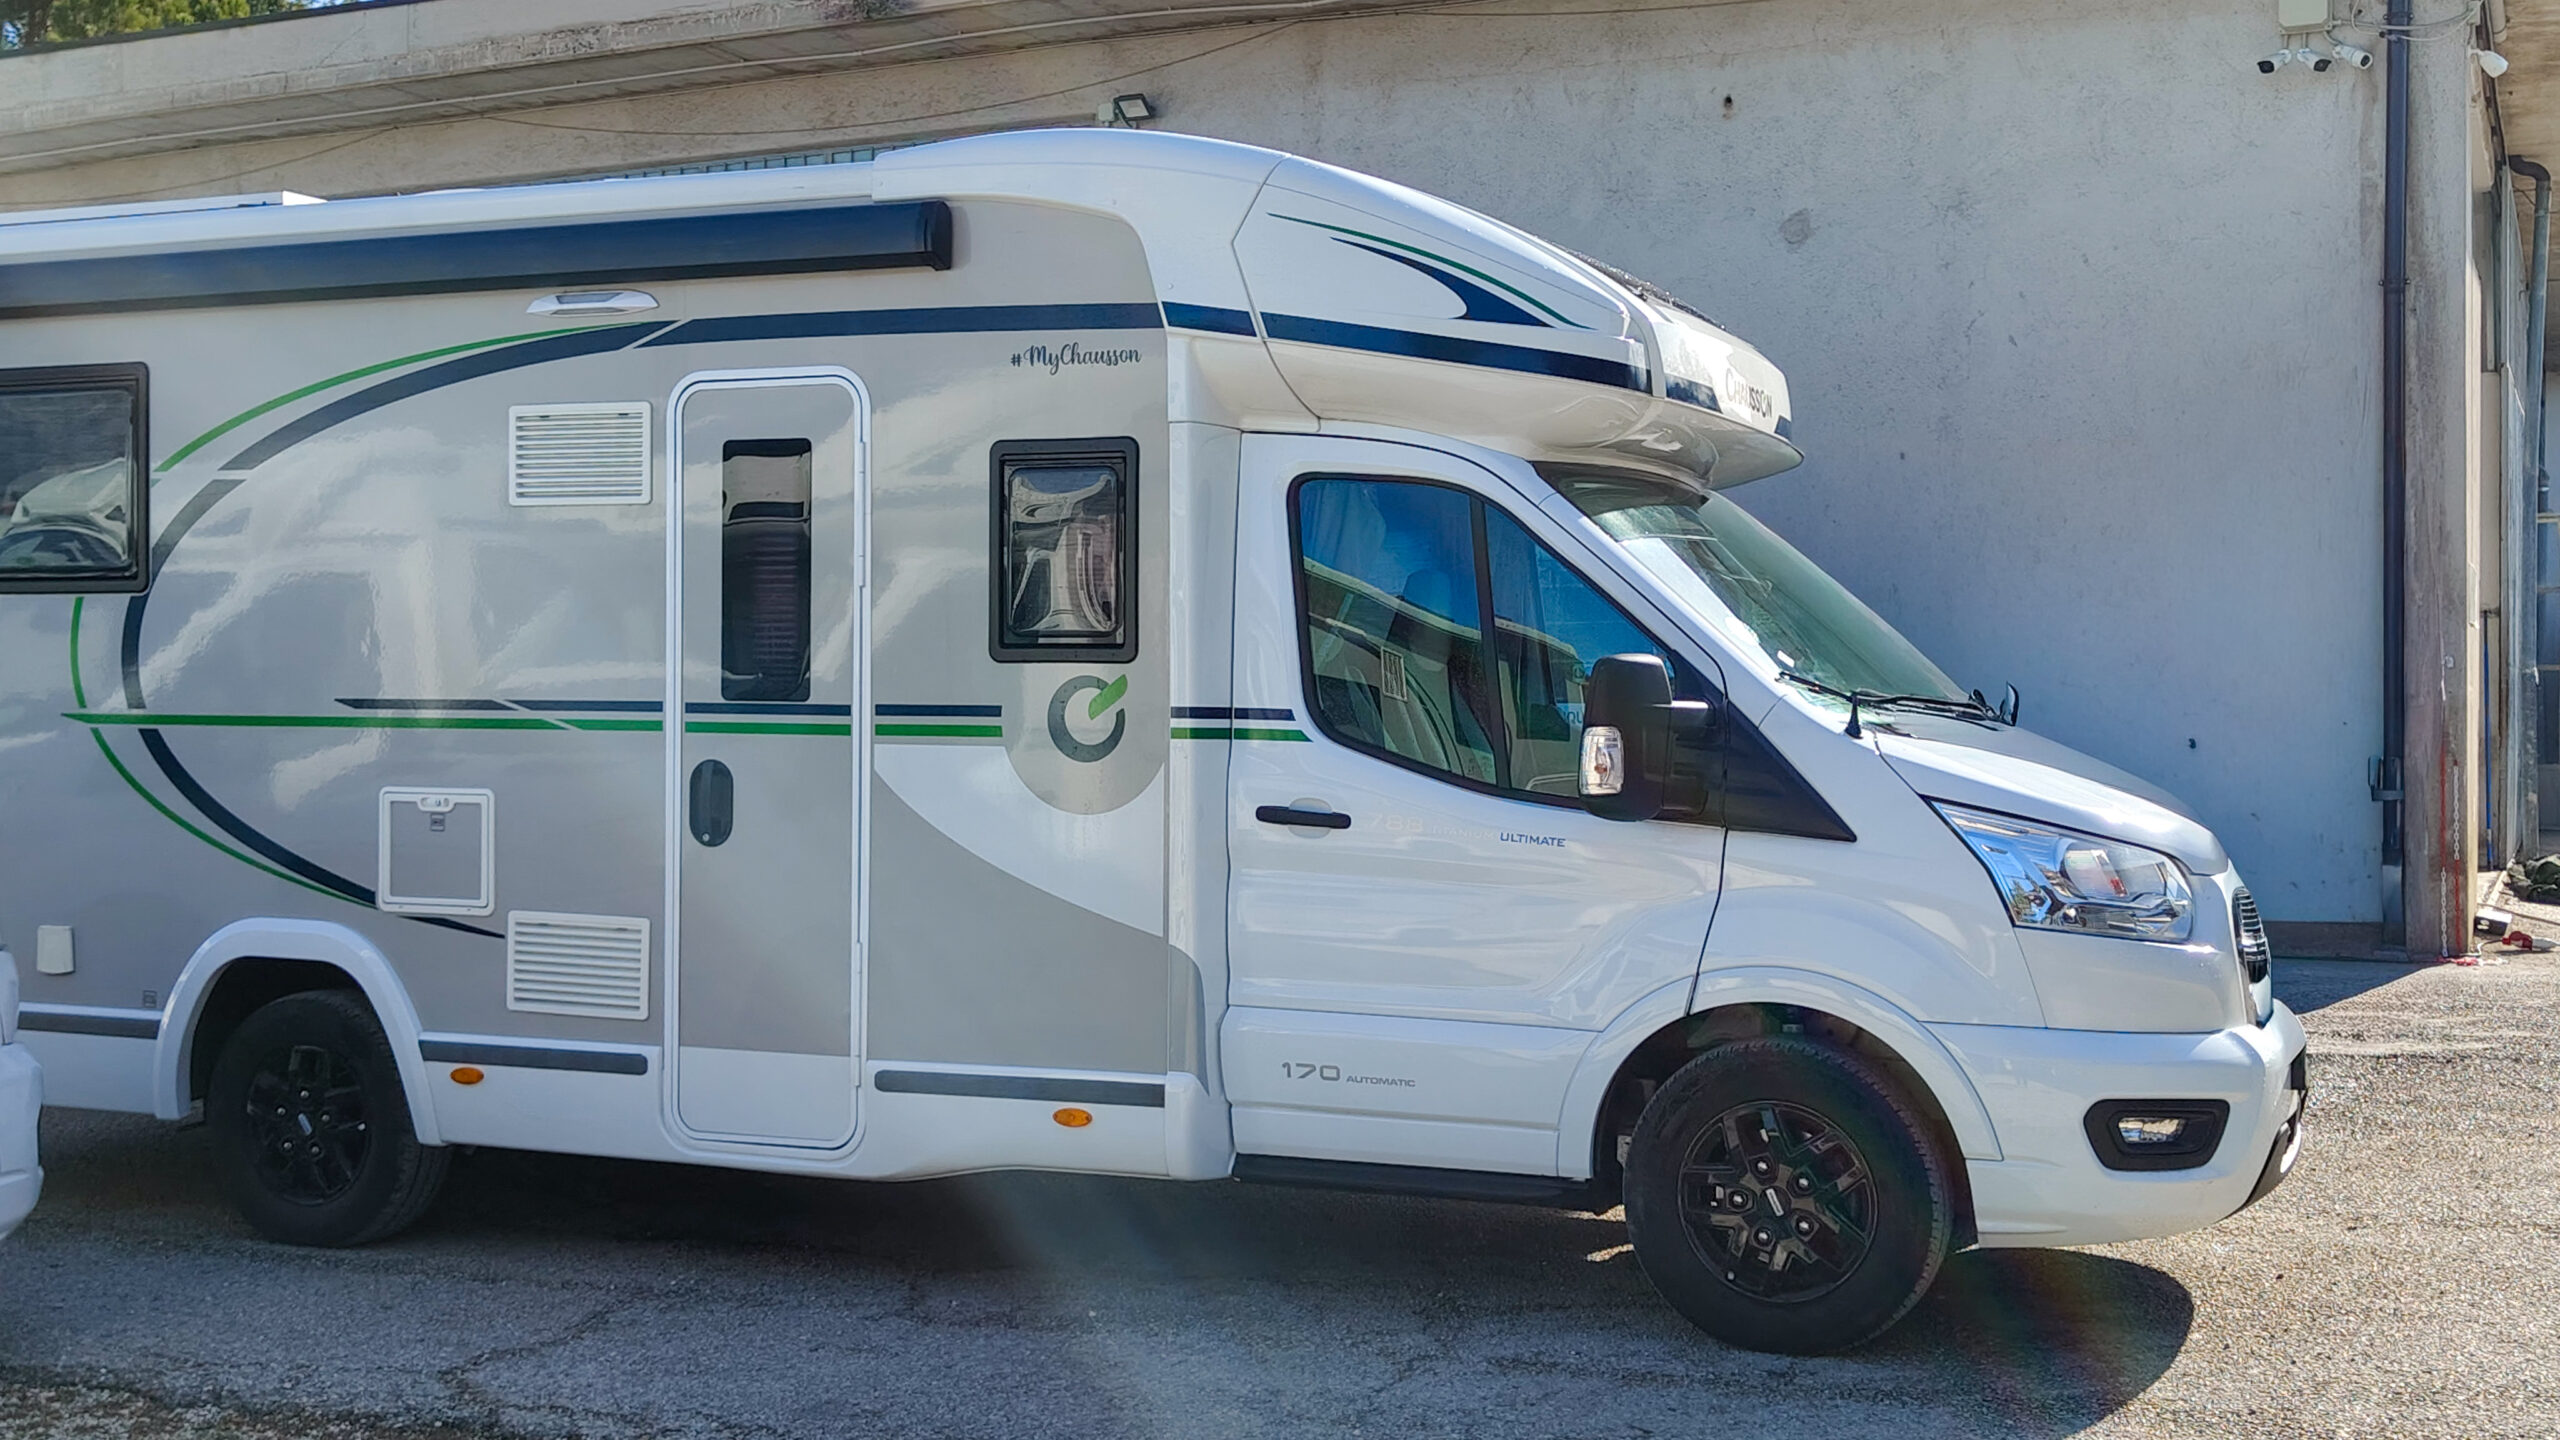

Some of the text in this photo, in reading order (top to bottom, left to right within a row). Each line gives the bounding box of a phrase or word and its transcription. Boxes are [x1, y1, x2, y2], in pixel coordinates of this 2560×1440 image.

[1010, 342, 1142, 375] #MyChausson
[1500, 832, 1566, 848] ULTIMATE
[1282, 1061, 1416, 1088] 170 AUTOMATIC
